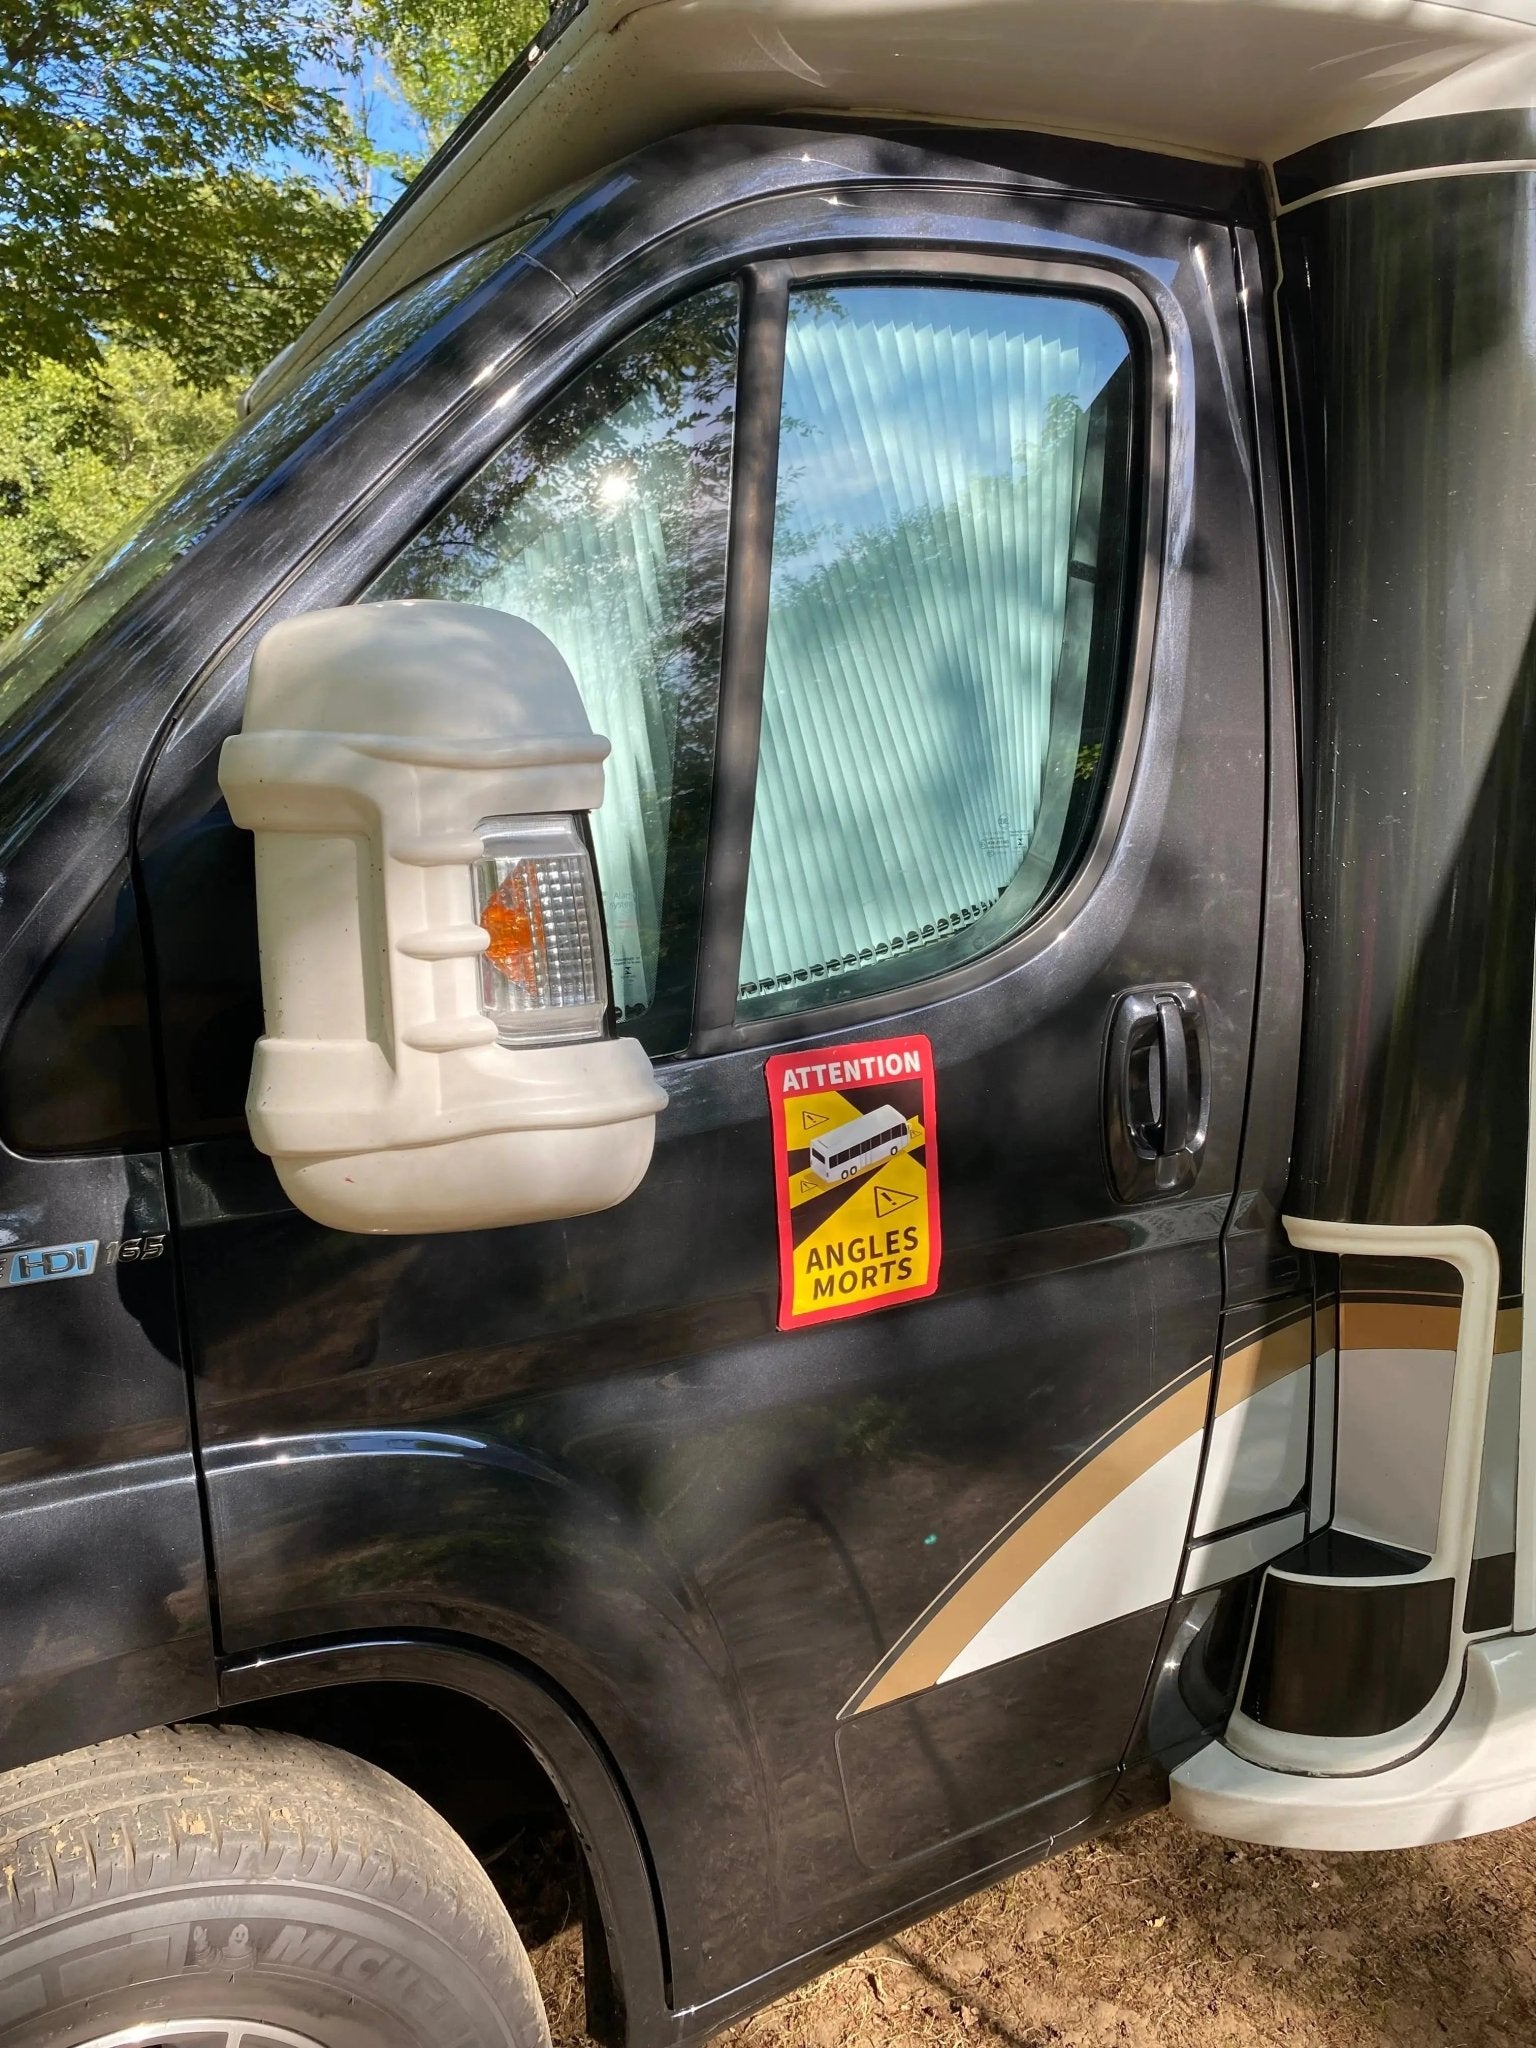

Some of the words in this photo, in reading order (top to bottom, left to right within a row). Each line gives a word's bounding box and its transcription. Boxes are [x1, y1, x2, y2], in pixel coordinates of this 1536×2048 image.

[783, 1051, 921, 1092] ATTENTION
[19, 1247, 87, 1278] HDI
[105, 1234, 166, 1265] 165
[806, 1226, 919, 1274] ANGLES
[813, 1257, 912, 1300] MORTS
